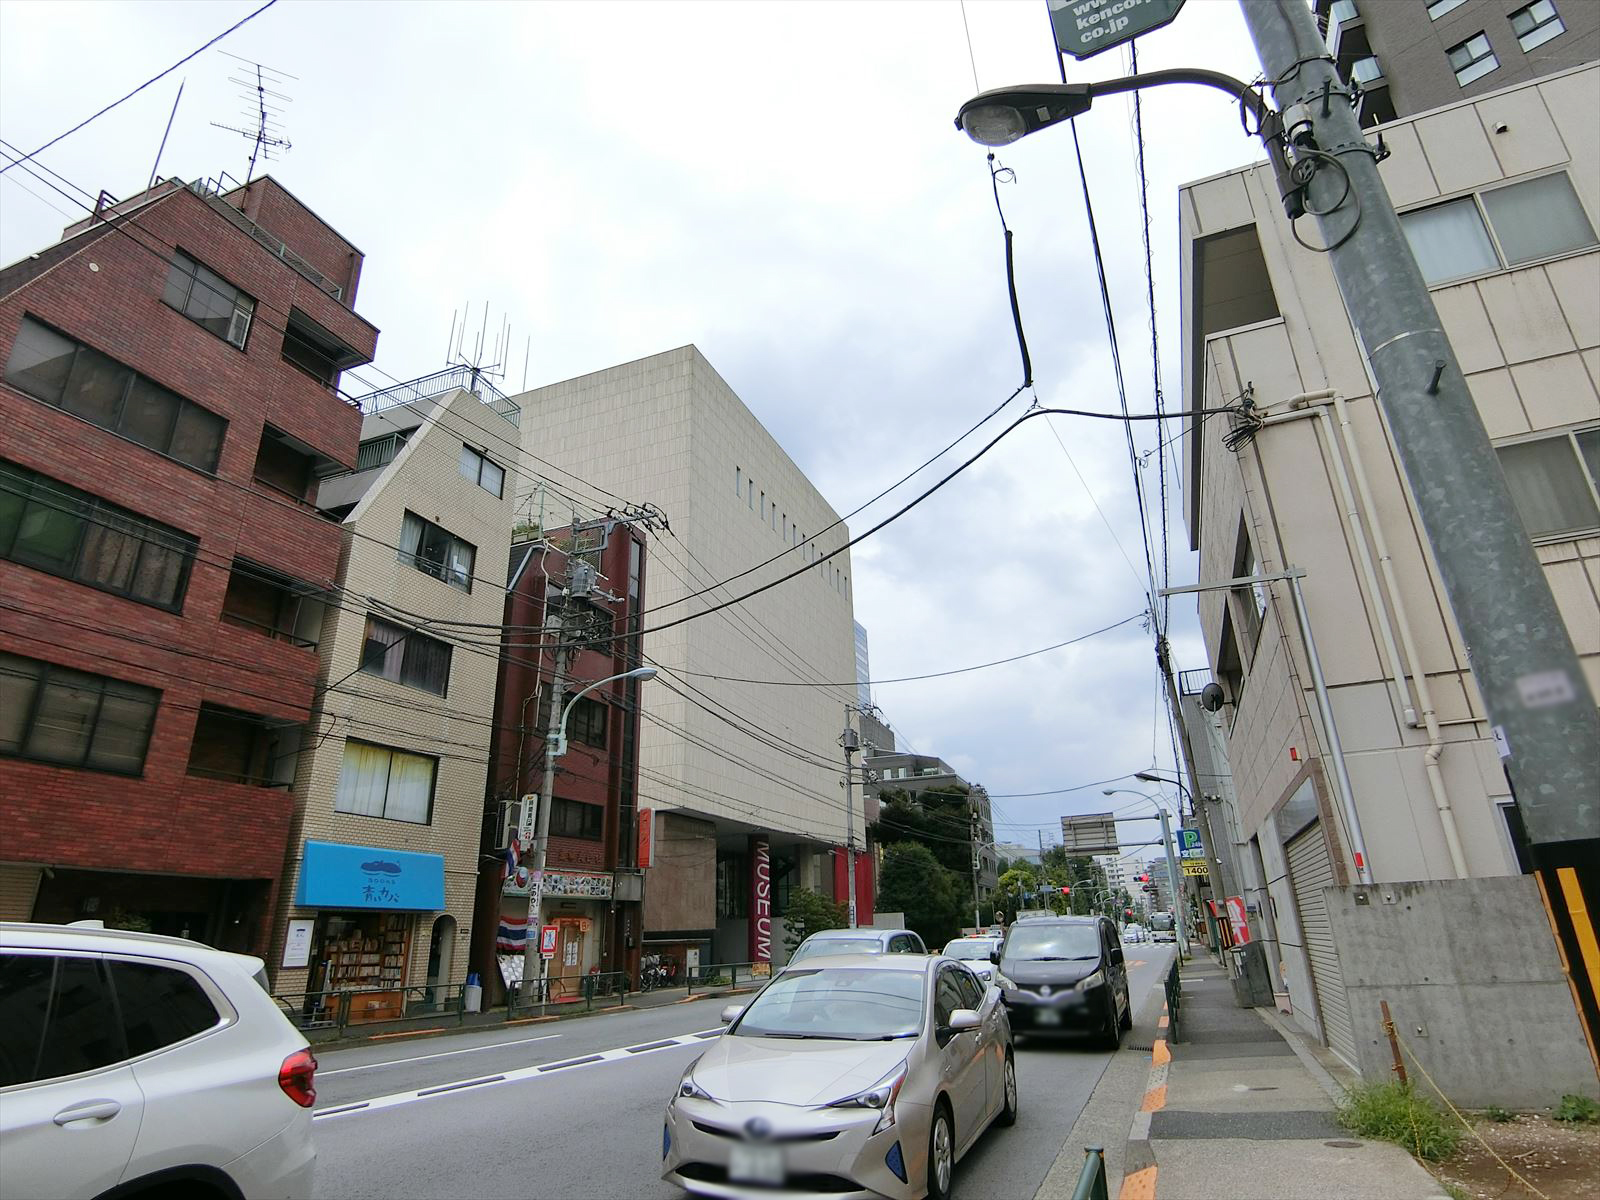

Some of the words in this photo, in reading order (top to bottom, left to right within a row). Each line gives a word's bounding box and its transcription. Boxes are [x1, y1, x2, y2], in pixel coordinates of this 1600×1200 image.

[1076, 0, 1151, 30] kenco
[1080, 16, 1129, 43] co.jp
[1183, 831, 1198, 849] P
[756, 841, 771, 960] MUSEUM
